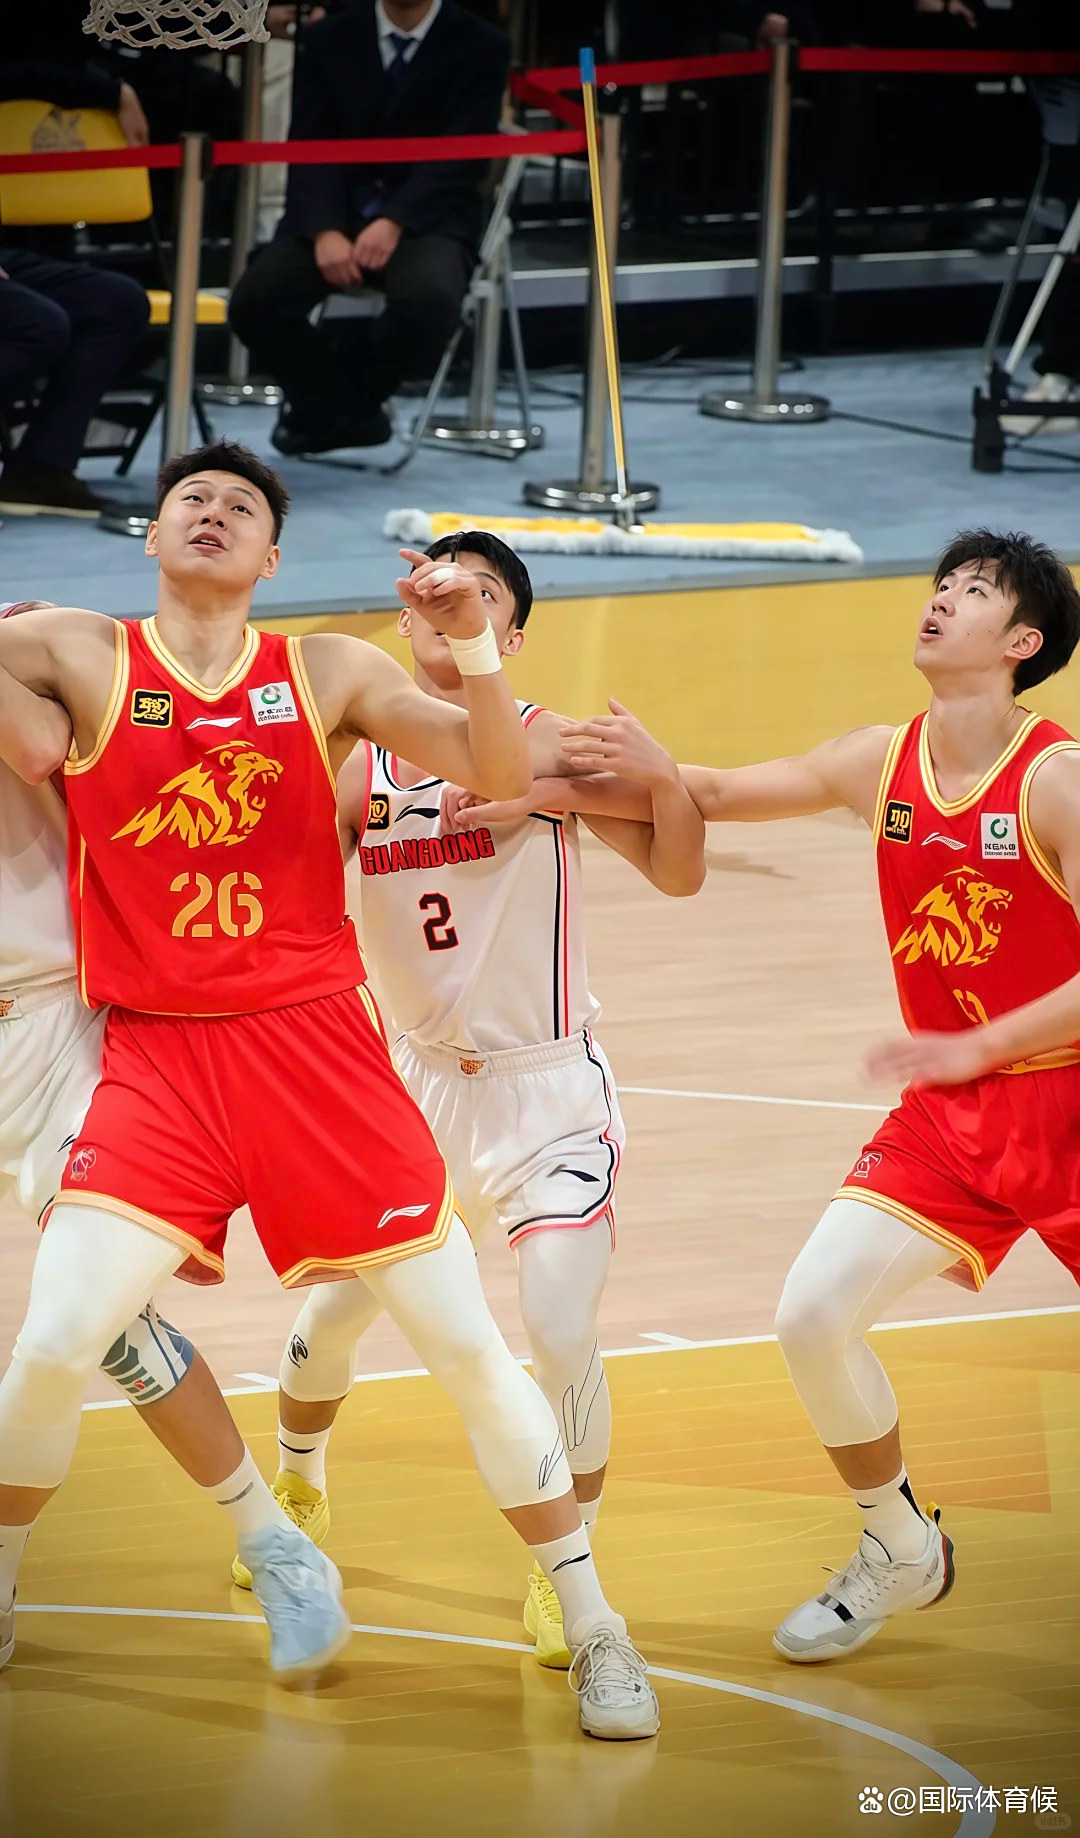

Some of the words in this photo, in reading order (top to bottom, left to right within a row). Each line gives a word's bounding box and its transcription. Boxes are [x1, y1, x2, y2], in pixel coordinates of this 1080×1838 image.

[358, 827, 496, 876] GUANGDONG
[169, 871, 264, 938] 26
[418, 892, 460, 952] 2
